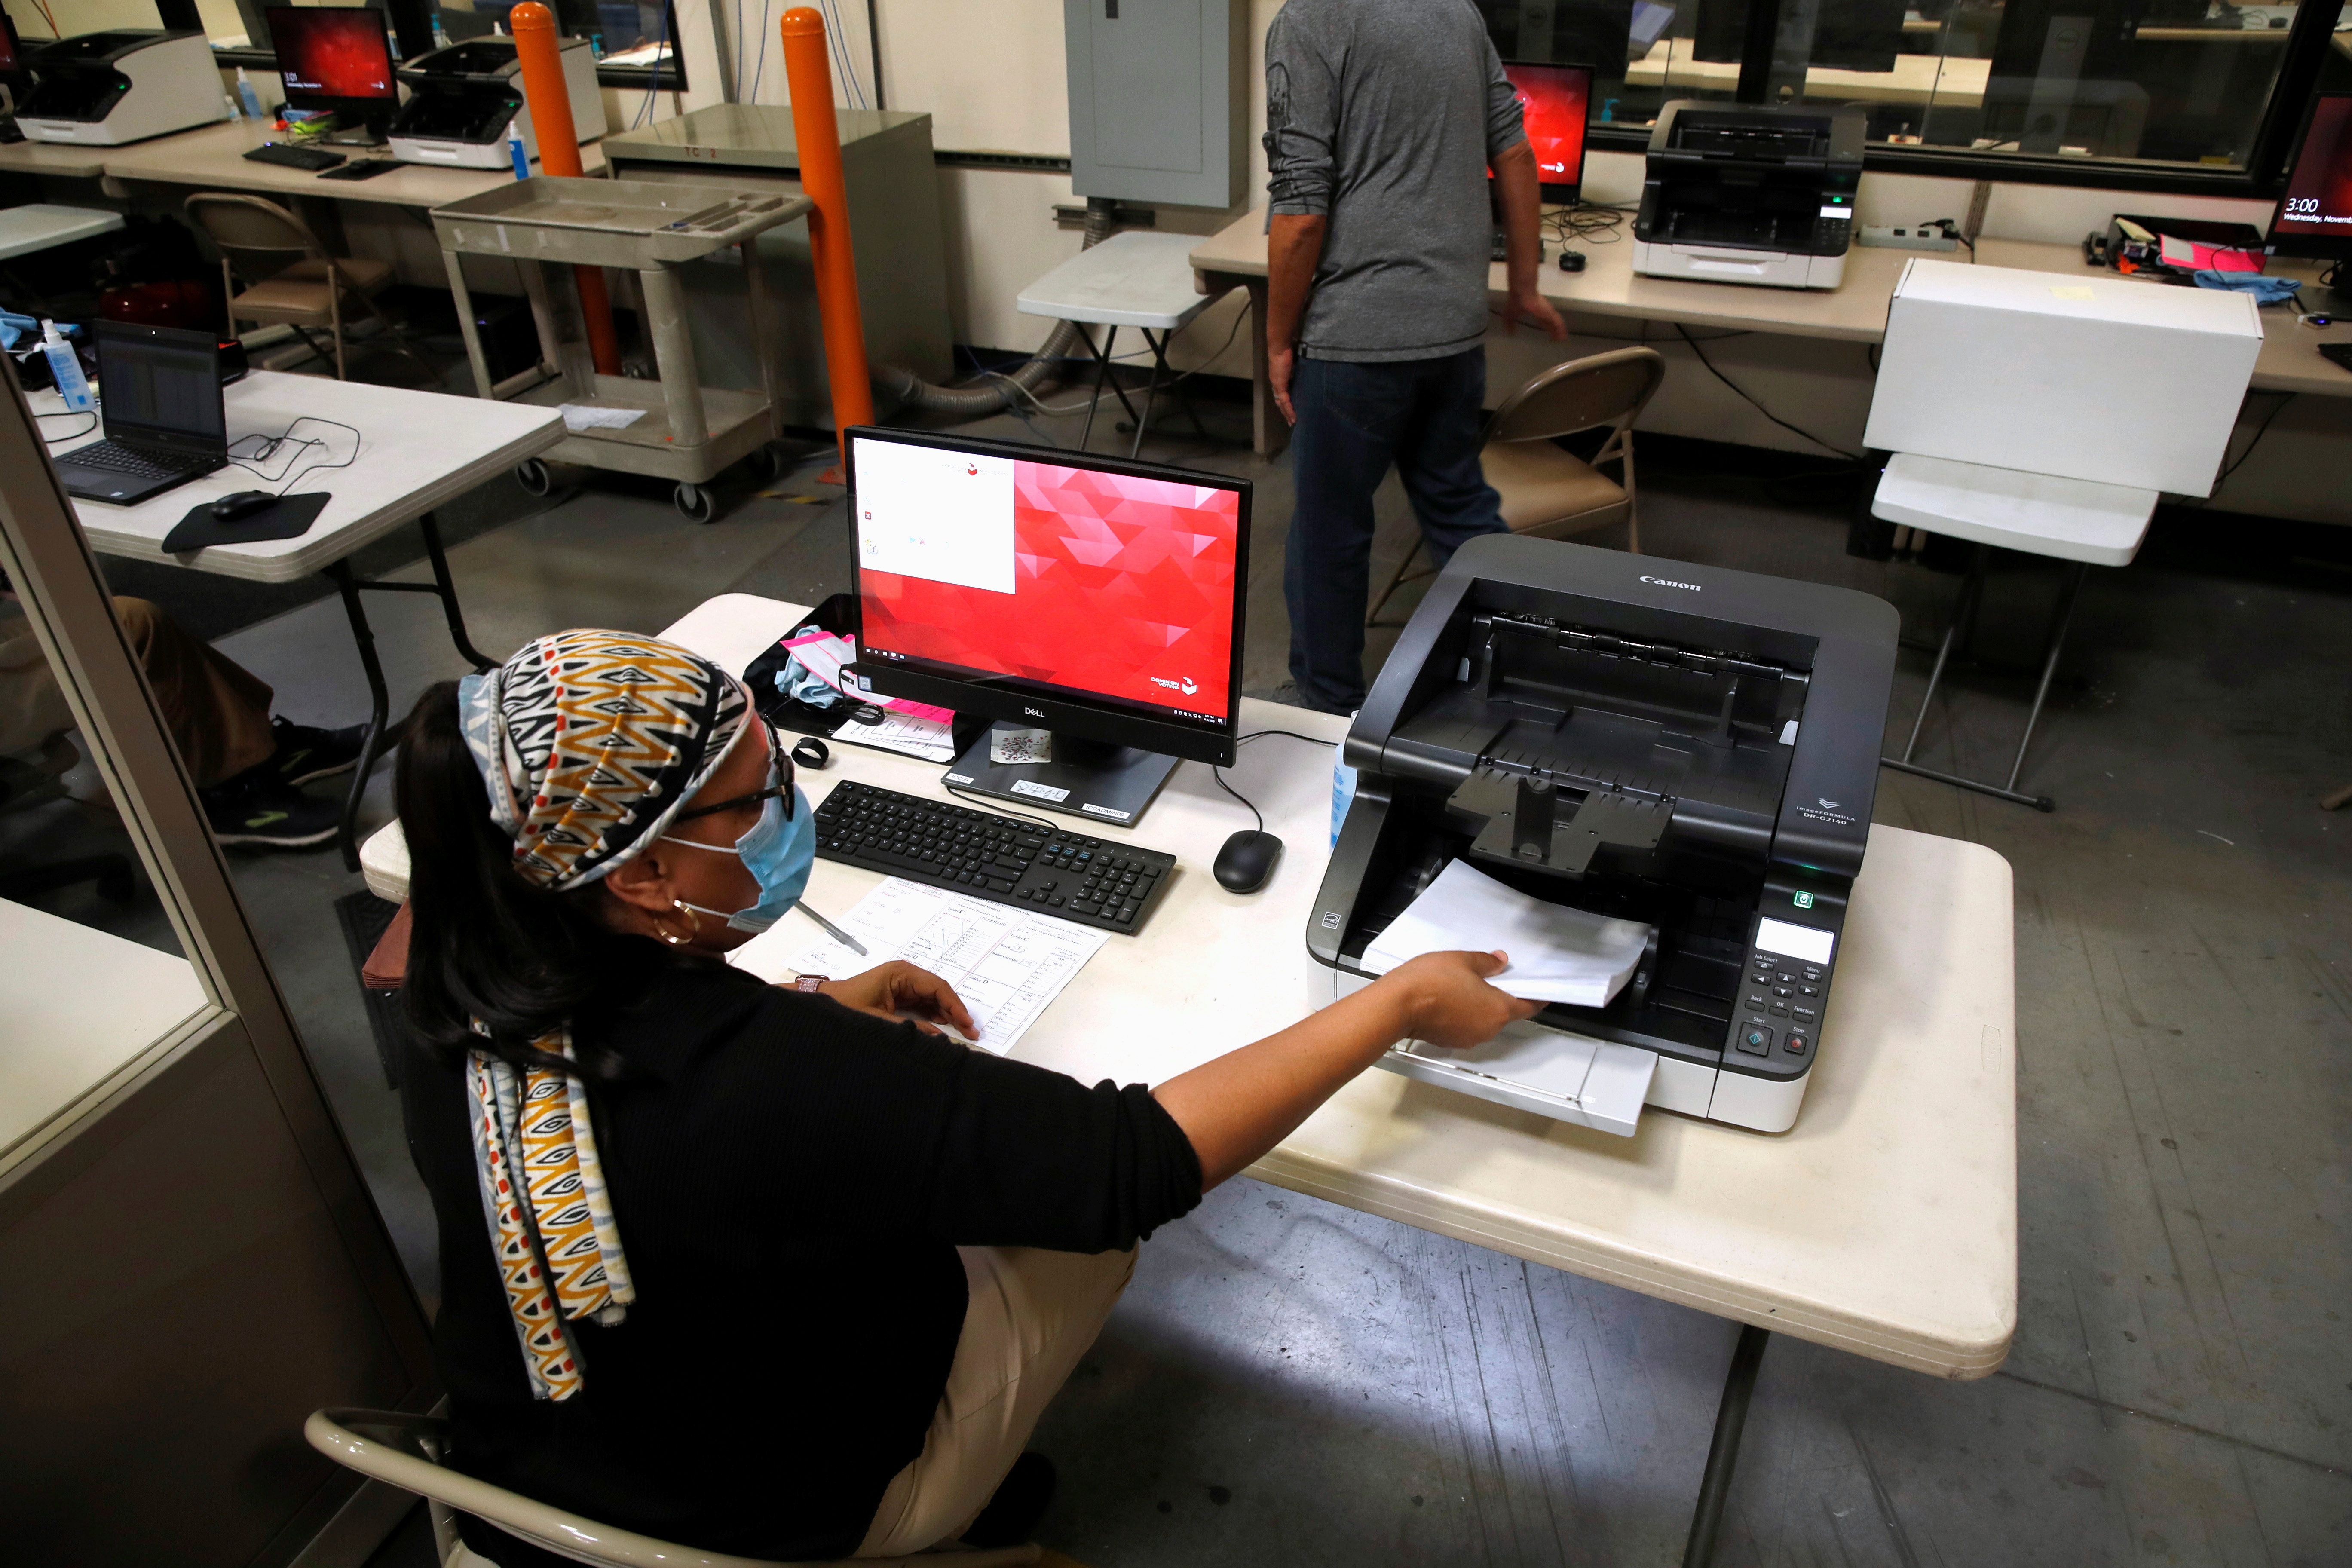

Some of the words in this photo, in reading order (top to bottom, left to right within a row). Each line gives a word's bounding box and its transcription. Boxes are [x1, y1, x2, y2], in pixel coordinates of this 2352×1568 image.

[2285, 198, 2318, 212] 3:00
[2283, 213, 2322, 224] Wednesday,
[1639, 576, 1701, 591] Canon
[1151, 677, 1179, 686] DOMINION
[1025, 707, 1045, 718] DELL
[1085, 805, 1125, 817] ICCADMIN09
[1803, 812, 1847, 825] DR-G2140
[1794, 1006, 1815, 1015] Function
